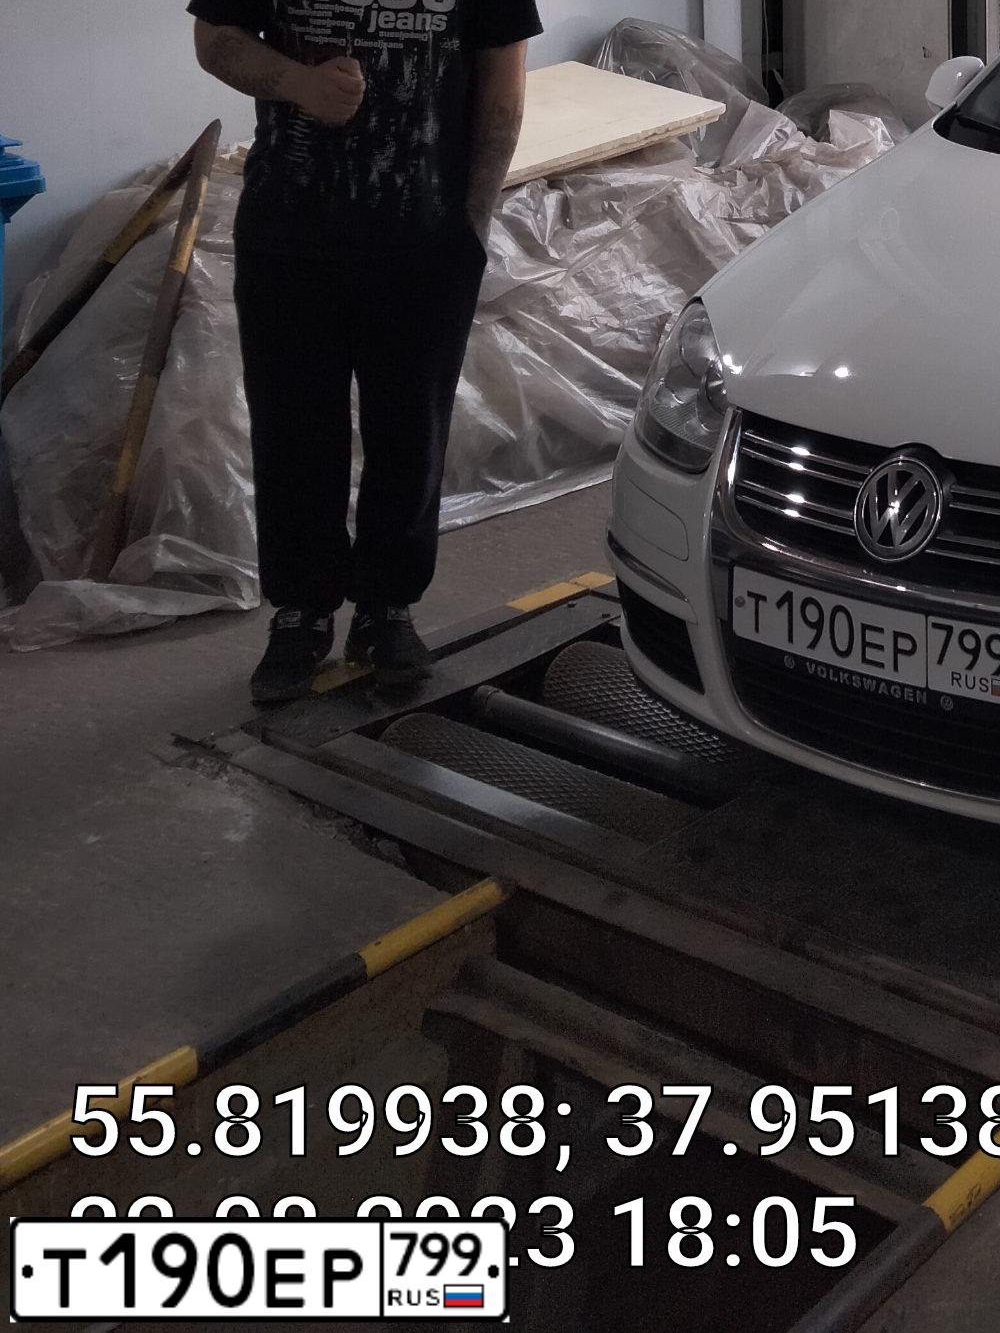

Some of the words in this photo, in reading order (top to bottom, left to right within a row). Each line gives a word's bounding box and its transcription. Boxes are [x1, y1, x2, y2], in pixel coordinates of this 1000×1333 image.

[367, 3, 448, 33] jeans
[746, 589, 918, 673] Т190ЕР
[805, 660, 928, 705] VOLKSWAGEN
[950, 671, 990, 693] RUS
